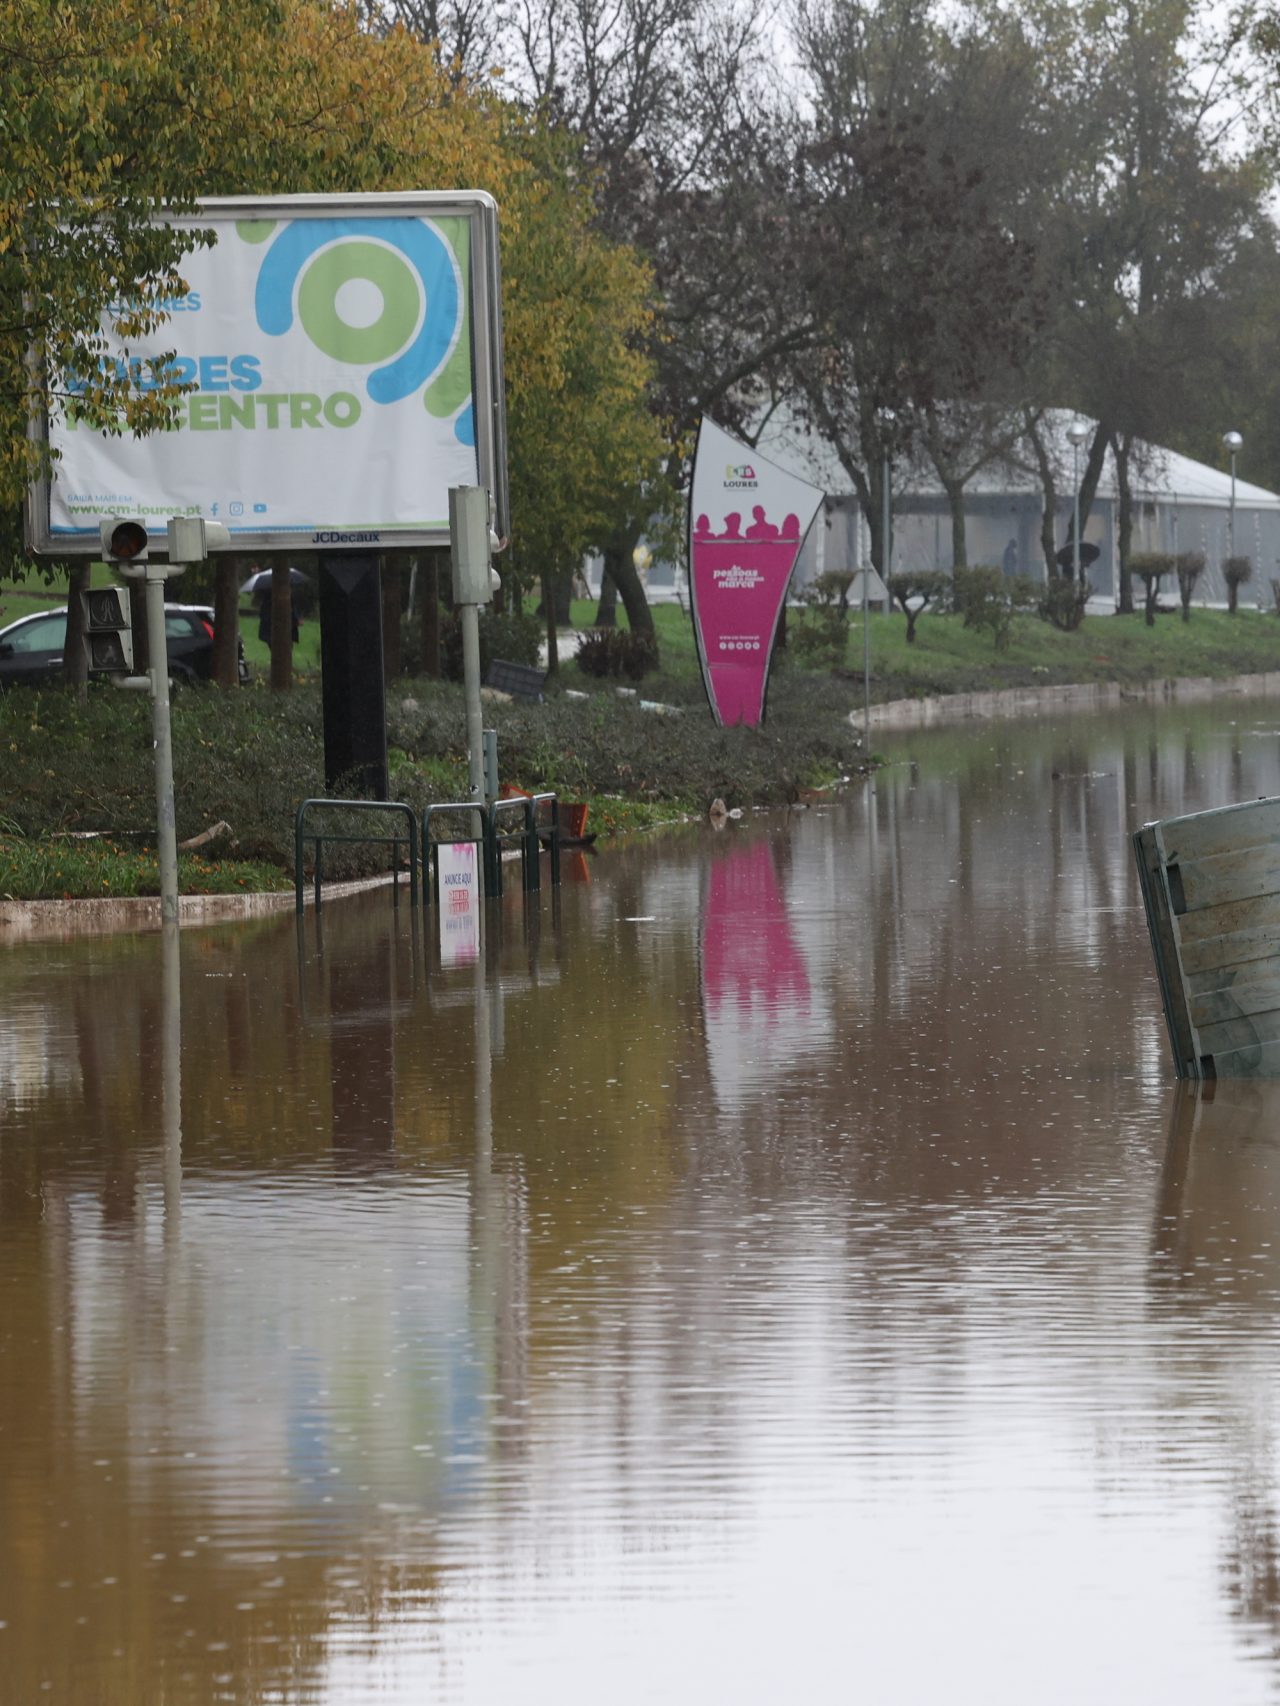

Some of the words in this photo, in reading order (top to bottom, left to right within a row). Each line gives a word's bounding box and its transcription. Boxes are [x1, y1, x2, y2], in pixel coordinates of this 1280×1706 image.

[106, 291, 202, 312] LRES
[66, 503, 202, 516] www.cm-loures.pt
[311, 531, 380, 544] JCDecaux
